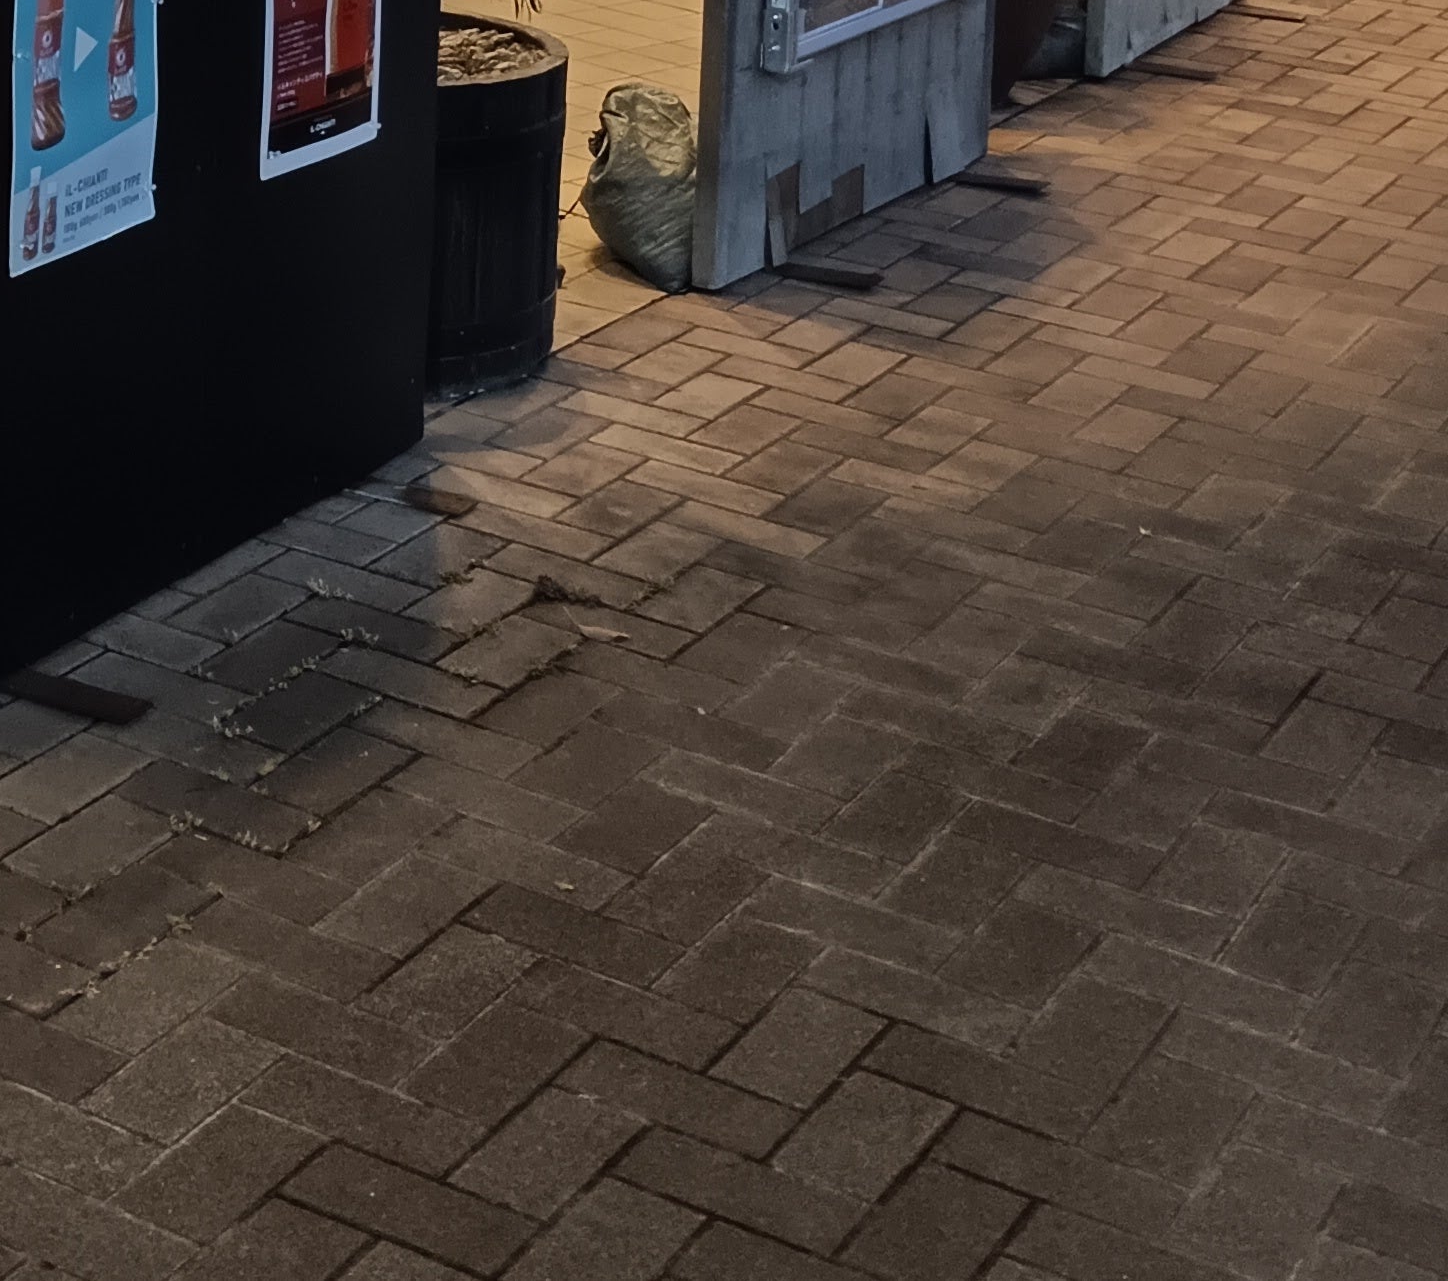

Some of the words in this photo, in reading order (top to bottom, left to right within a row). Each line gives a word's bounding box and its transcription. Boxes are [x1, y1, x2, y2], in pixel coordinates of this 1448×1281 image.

[64, 198, 84, 218] NEW
[84, 181, 122, 210] DRESSING
[123, 172, 142, 192] TYPE
